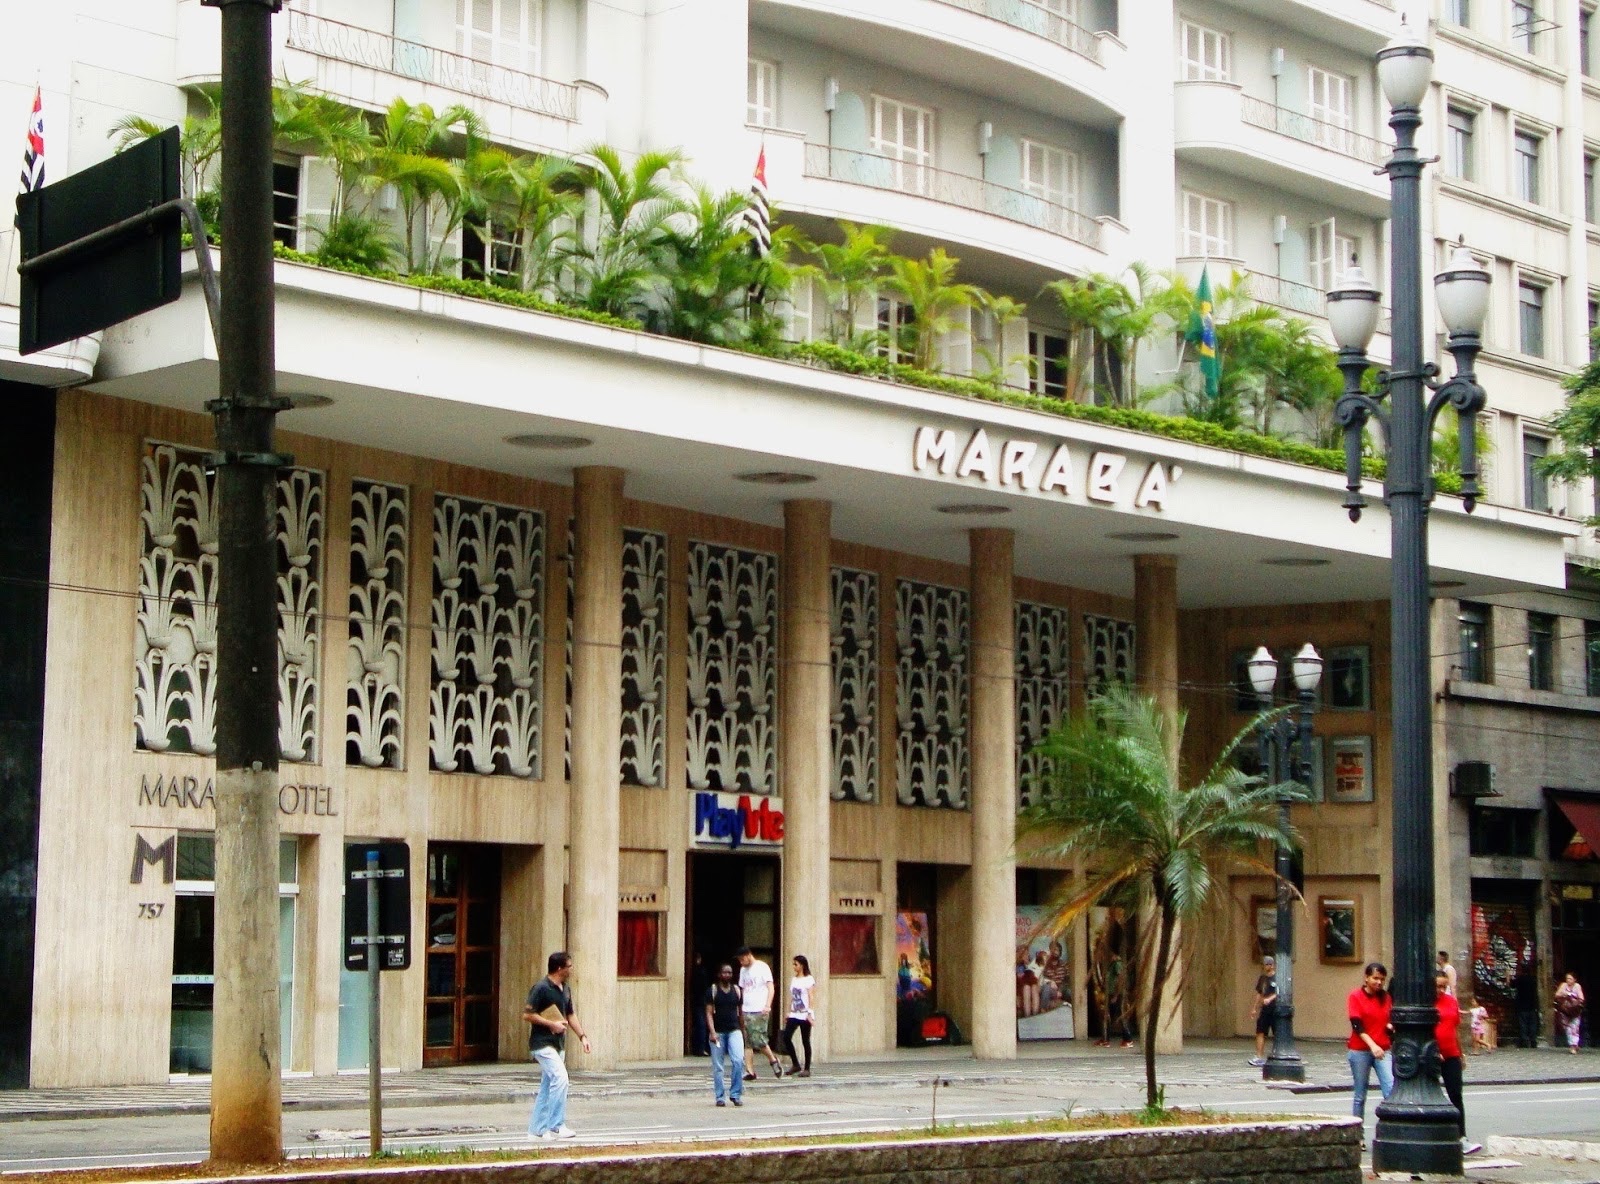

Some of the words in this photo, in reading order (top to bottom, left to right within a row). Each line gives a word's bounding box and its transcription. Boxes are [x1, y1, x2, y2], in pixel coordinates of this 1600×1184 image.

[139, 773, 216, 809] MARA
[278, 783, 339, 816] OTEL
[130, 832, 175, 884] M
[138, 902, 165, 919] 757
